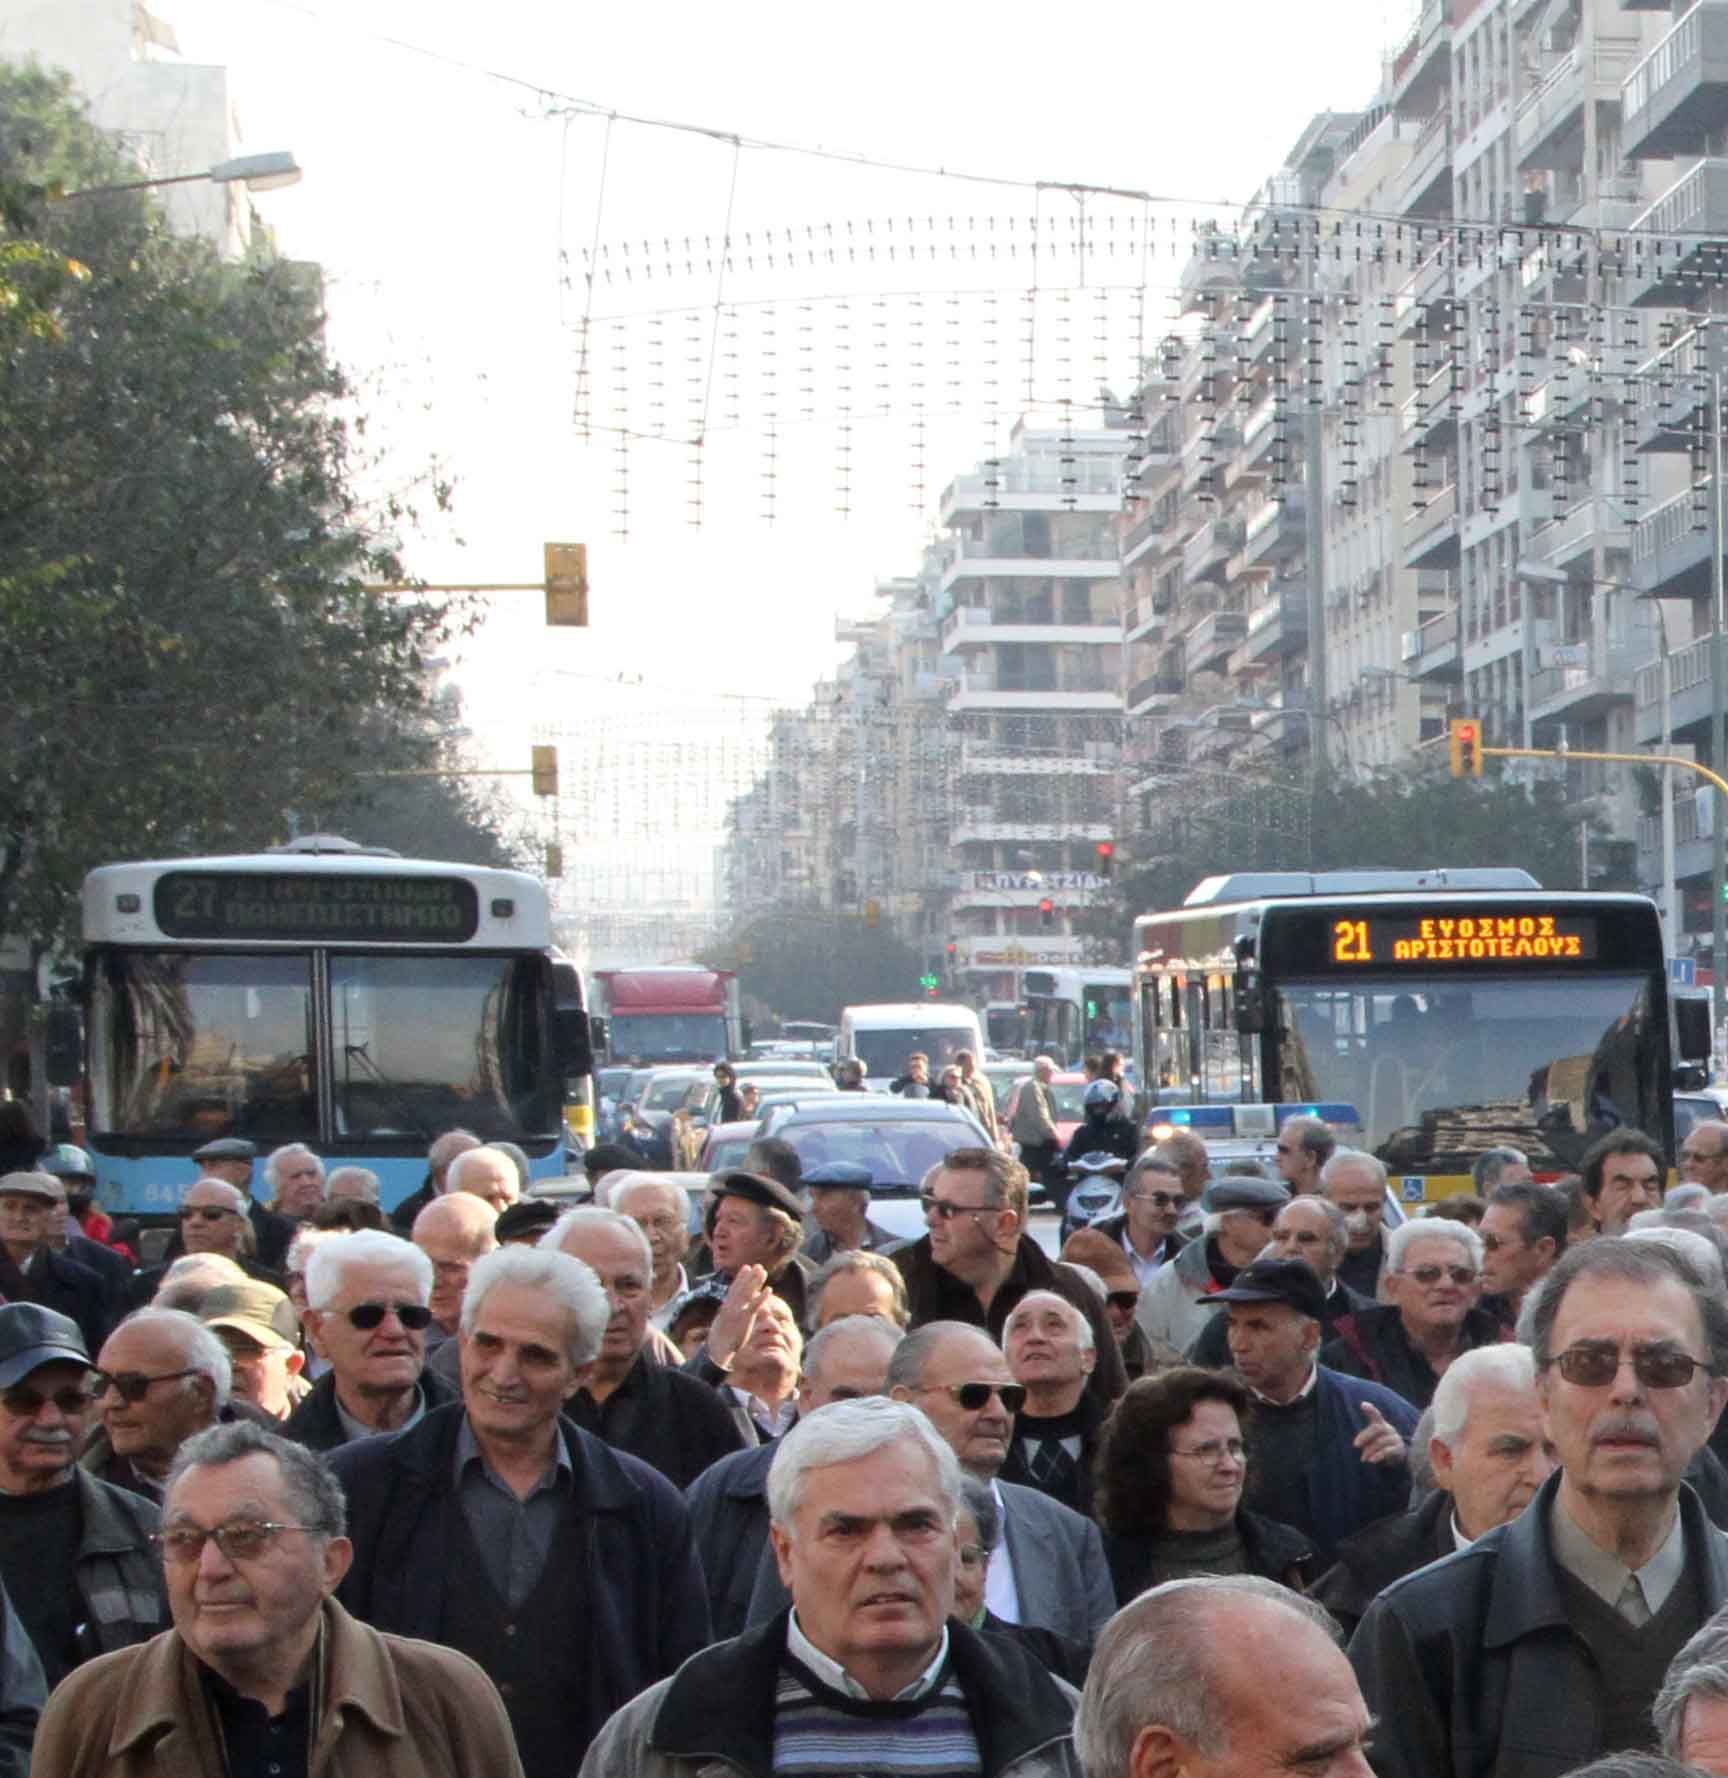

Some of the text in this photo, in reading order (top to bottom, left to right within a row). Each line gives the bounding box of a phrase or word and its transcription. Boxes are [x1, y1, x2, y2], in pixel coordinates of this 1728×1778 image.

[1420, 917, 1556, 939] ΕΥΟΣΜΟΣ
[1334, 920, 1372, 961] 21
[1394, 936, 1582, 960] ΑΡΙΣΤΟΤΕΛΟΥΣ
